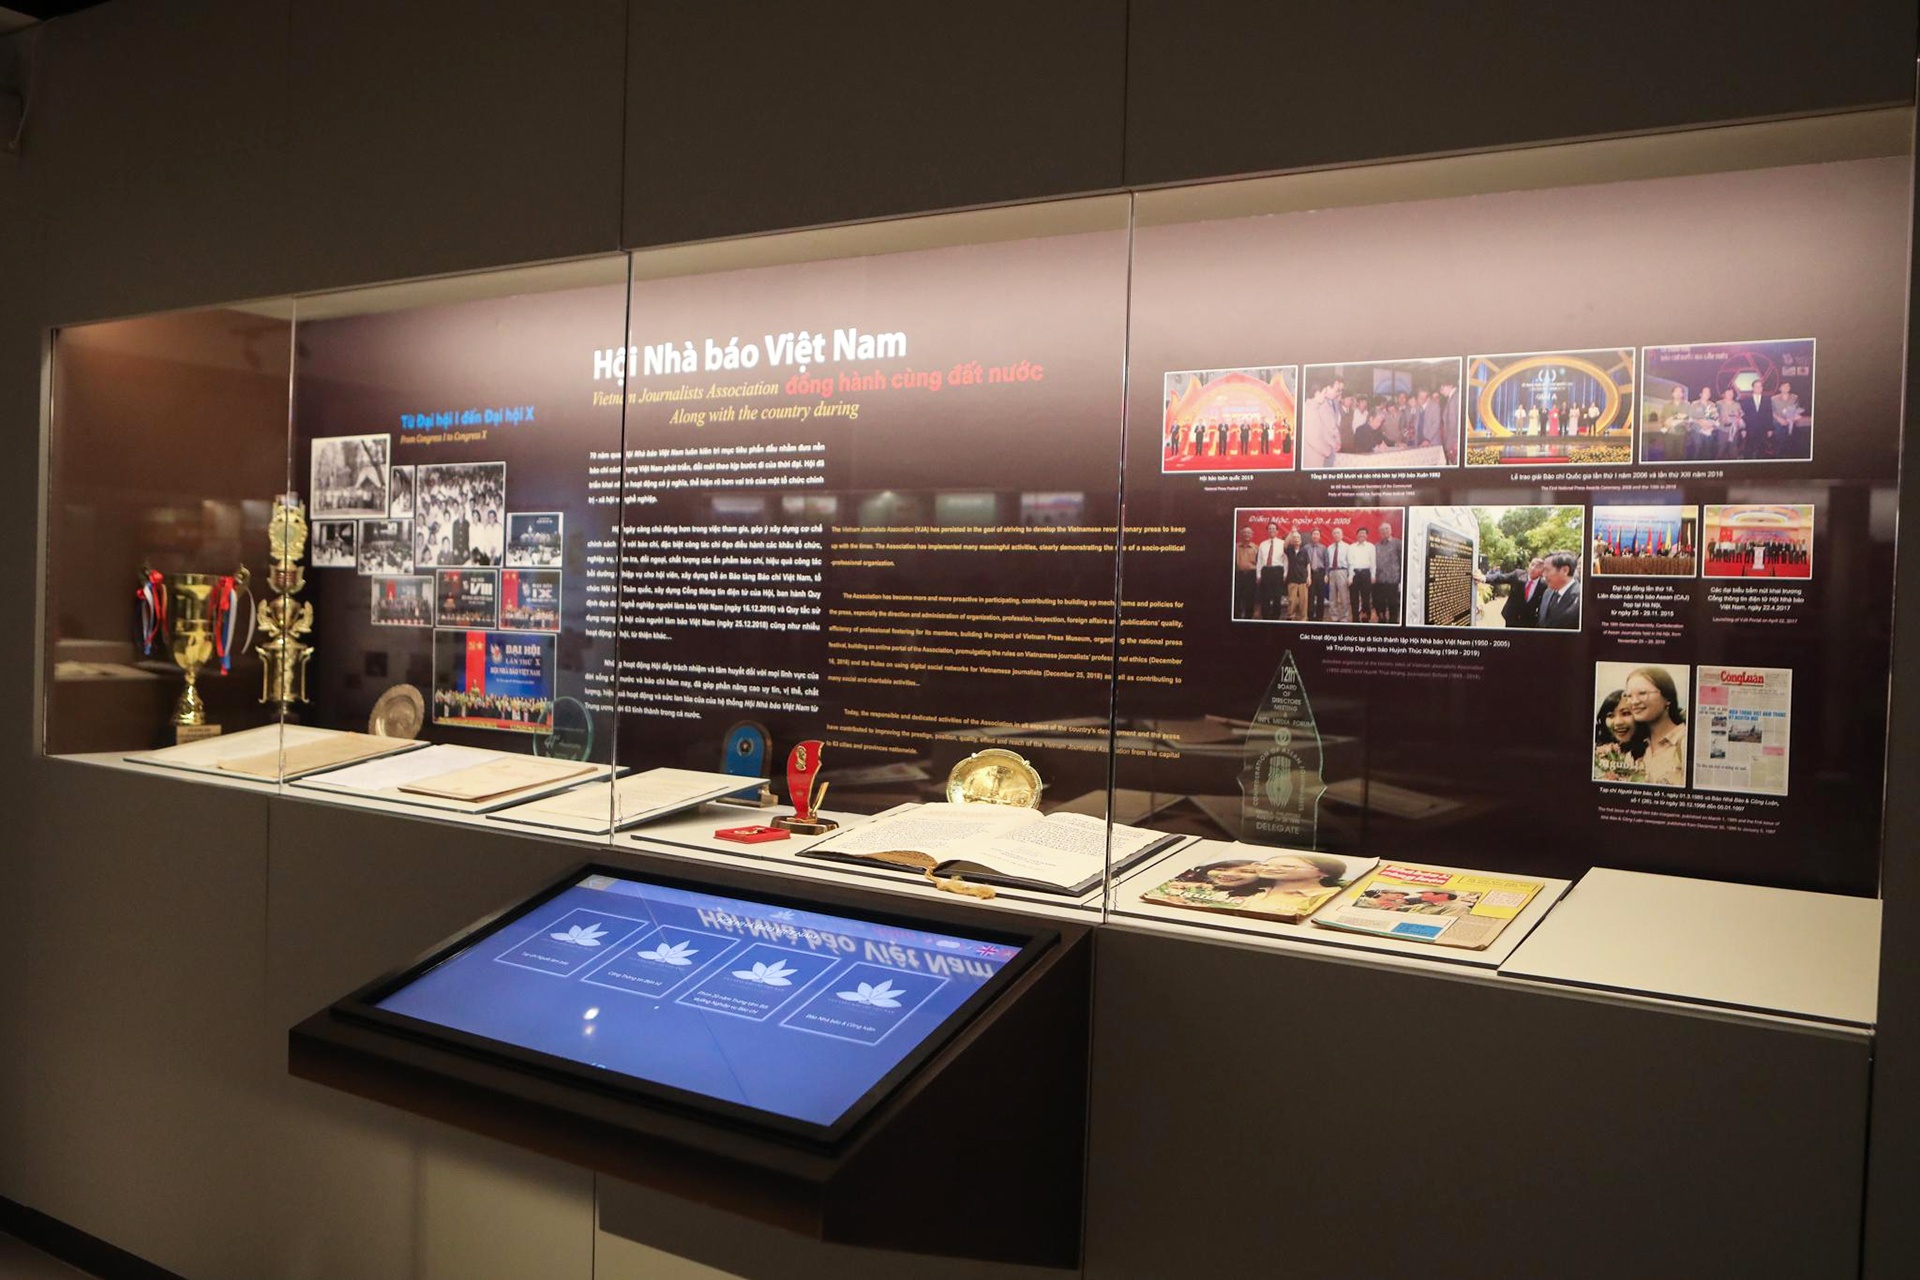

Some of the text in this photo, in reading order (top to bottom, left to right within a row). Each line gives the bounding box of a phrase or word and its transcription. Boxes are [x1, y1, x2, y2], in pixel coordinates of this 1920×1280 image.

[594, 330, 906, 386] Hội Nhà báo Việt Nam
[638, 385, 704, 403] Journalists
[706, 380, 778, 398] Association
[784, 361, 1044, 398] đồng hành cùng đất nước
[416, 412, 435, 430] Đại
[436, 411, 453, 430] hội
[454, 412, 459, 425] I
[484, 408, 502, 426] Đại
[505, 406, 523, 426] hội
[526, 406, 535, 420] X
[669, 401, 860, 426] Along with the country during
[416, 434, 442, 444] Congress
[454, 431, 480, 442] Congress
[482, 430, 488, 440] X
[1256, 822, 1300, 835] DELEGATE
